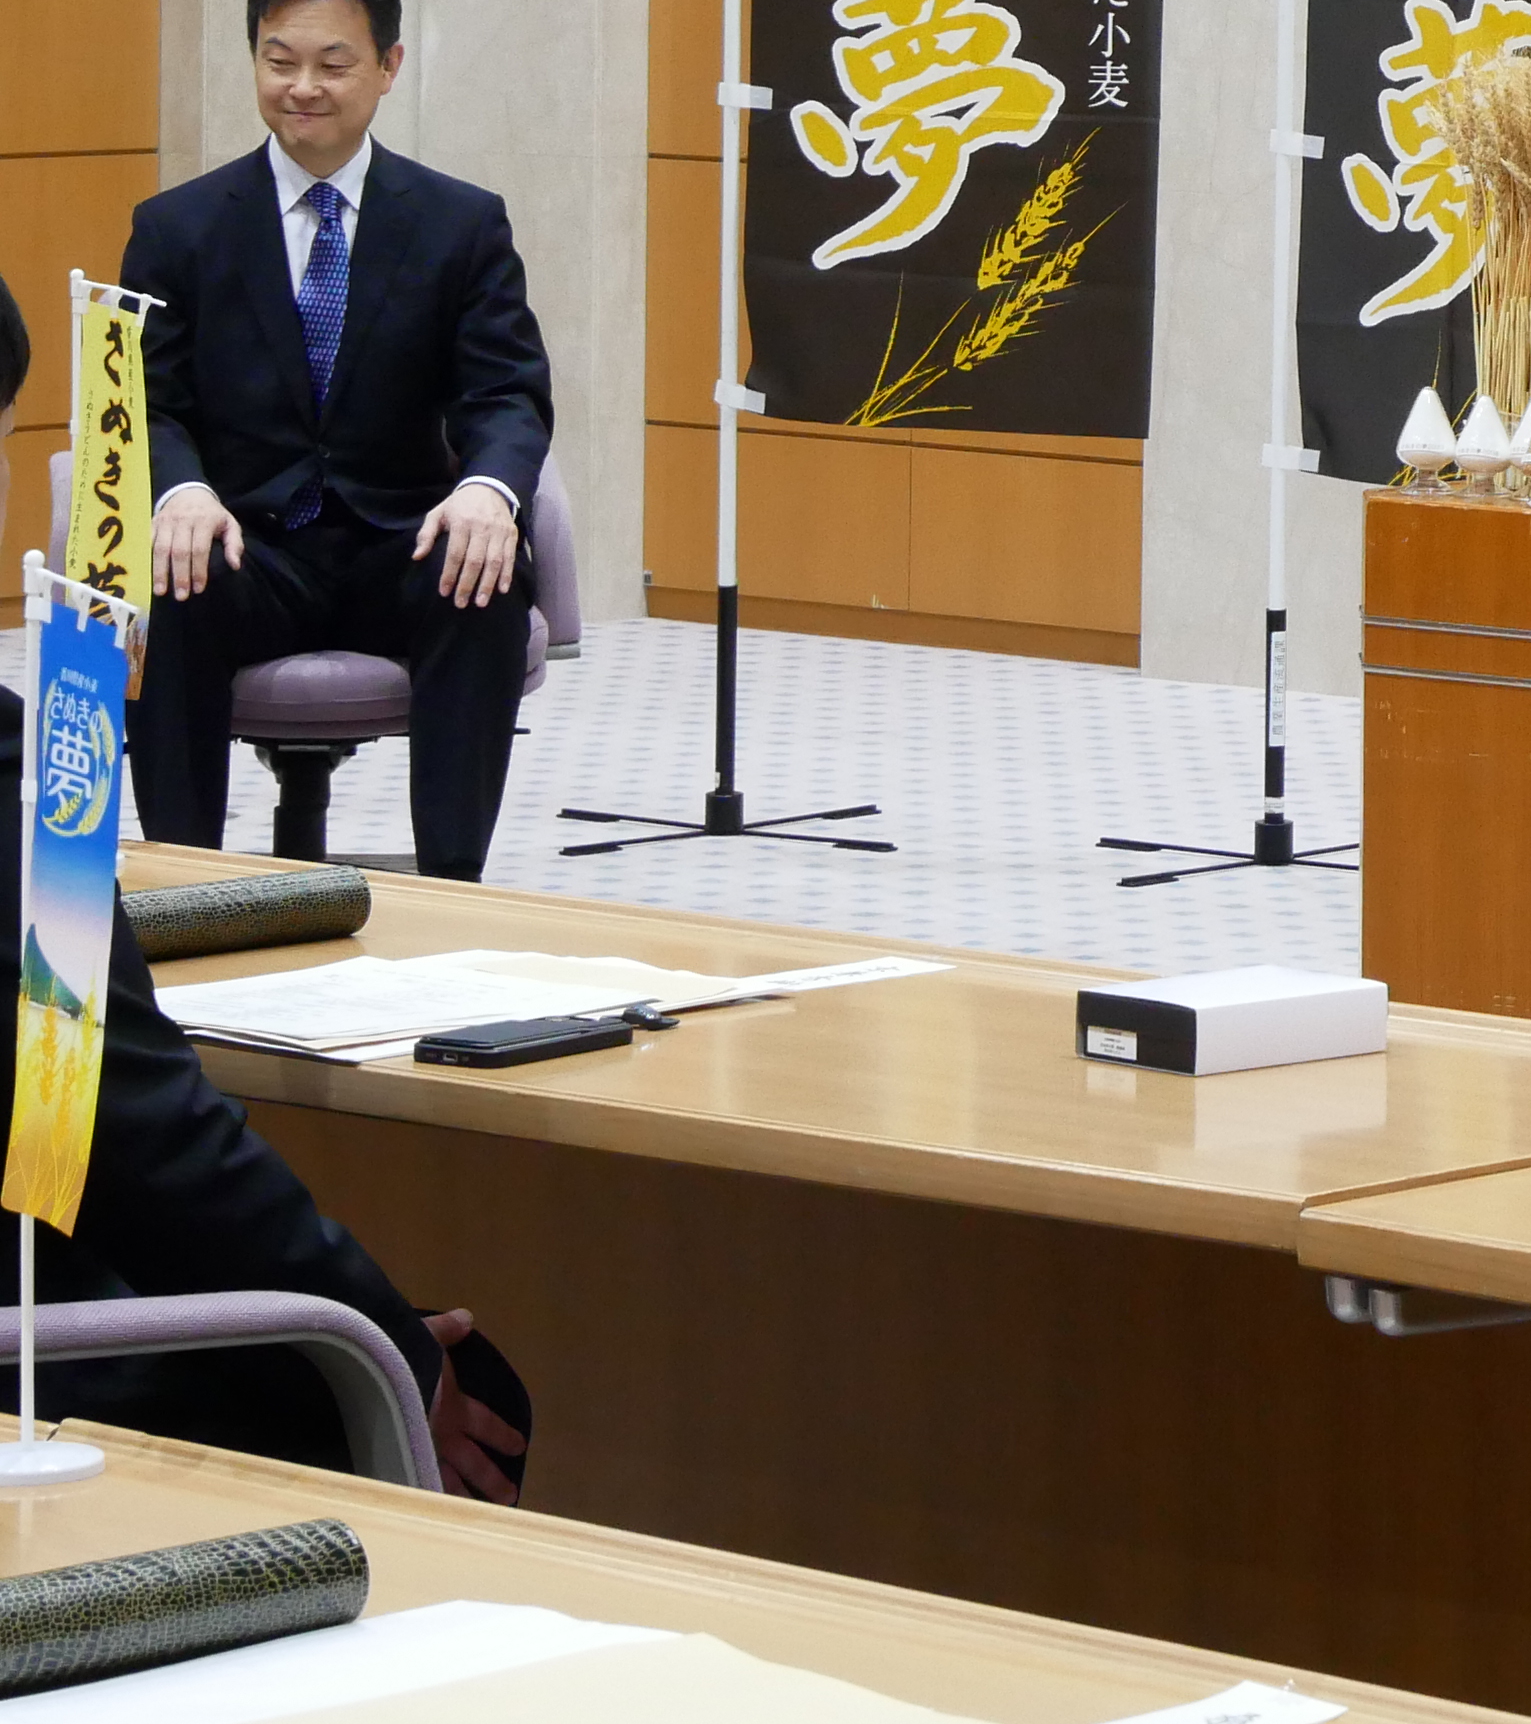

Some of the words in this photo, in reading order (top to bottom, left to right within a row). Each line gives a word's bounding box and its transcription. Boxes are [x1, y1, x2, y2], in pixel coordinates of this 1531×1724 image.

[50, 687, 103, 733] さぬきの
[47, 724, 93, 821] 夢
